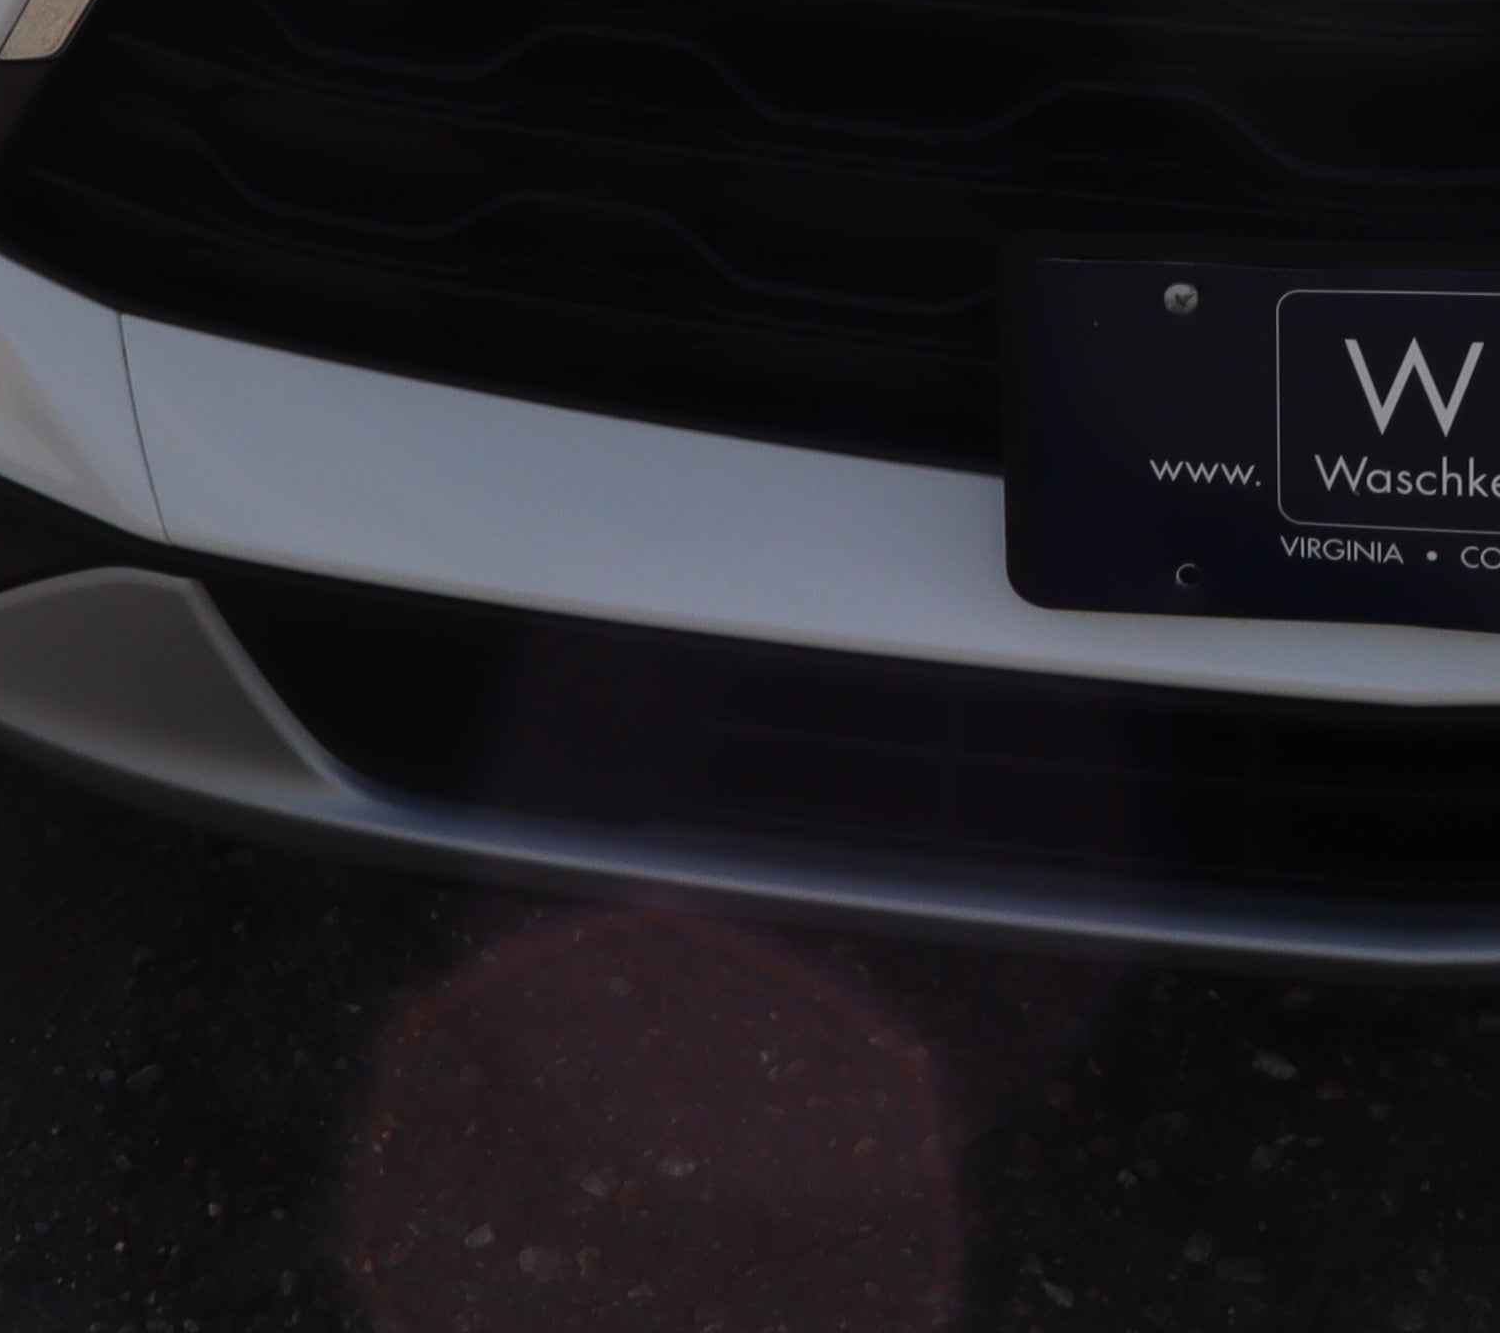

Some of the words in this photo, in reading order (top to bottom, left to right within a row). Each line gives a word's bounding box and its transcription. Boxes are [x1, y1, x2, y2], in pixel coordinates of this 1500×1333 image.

[1344, 337, 1485, 437] W
[1149, 458, 1262, 488] www.
[1280, 534, 1406, 566] VIRGINIA
